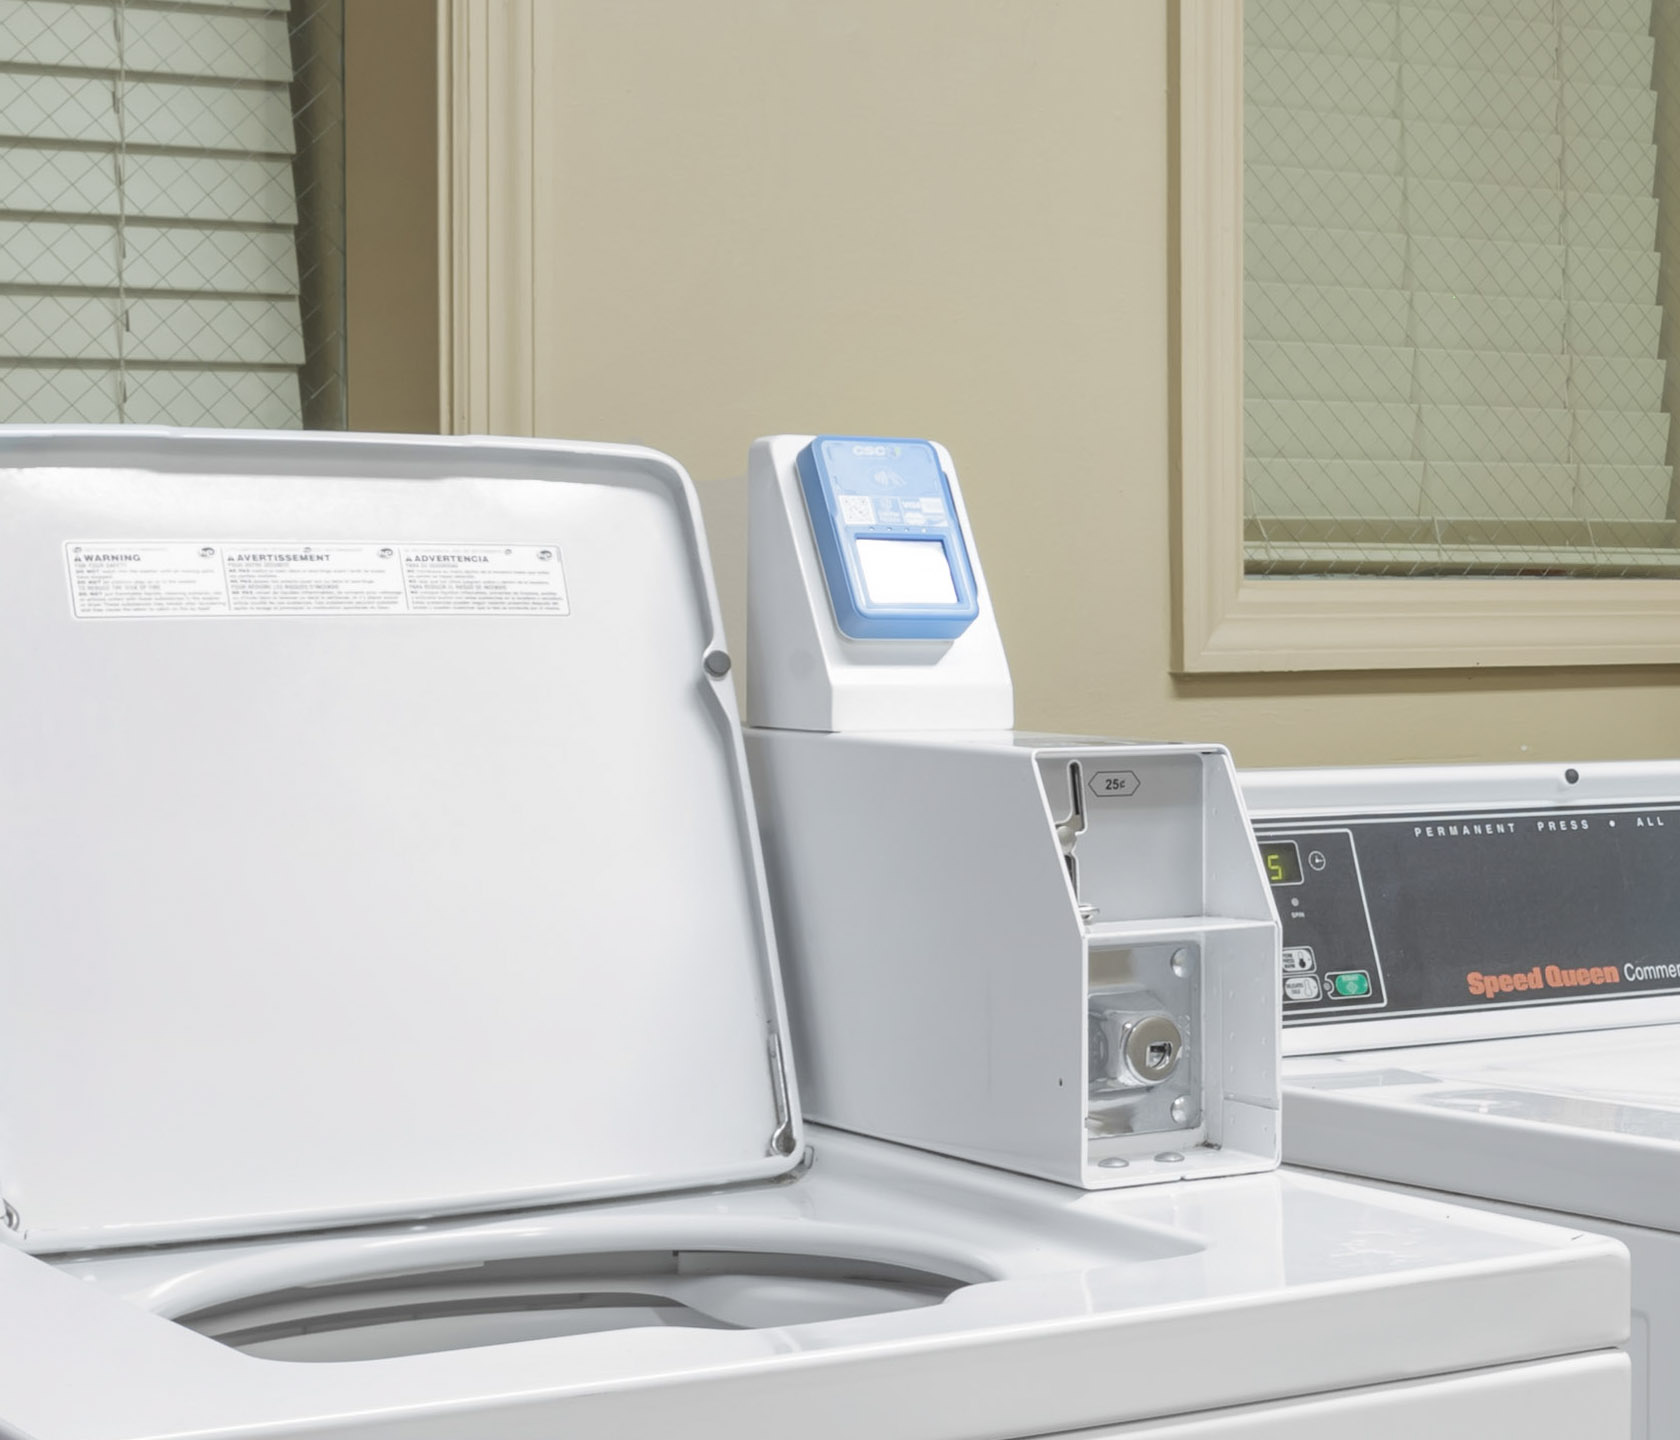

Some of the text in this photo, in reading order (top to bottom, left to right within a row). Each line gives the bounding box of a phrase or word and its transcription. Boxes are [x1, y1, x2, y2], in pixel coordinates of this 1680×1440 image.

[83, 553, 141, 562] WARNING
[237, 554, 330, 562] AVERTISSEMENT
[414, 555, 489, 563] ADVERTENCIA
[1105, 778, 1126, 790] 25¢
[1414, 822, 1515, 837] PERMANENT
[1537, 819, 1589, 831] PRESS
[1636, 816, 1664, 827] ALL
[1466, 965, 1544, 998] Speed
[1544, 964, 1620, 988] Queen
